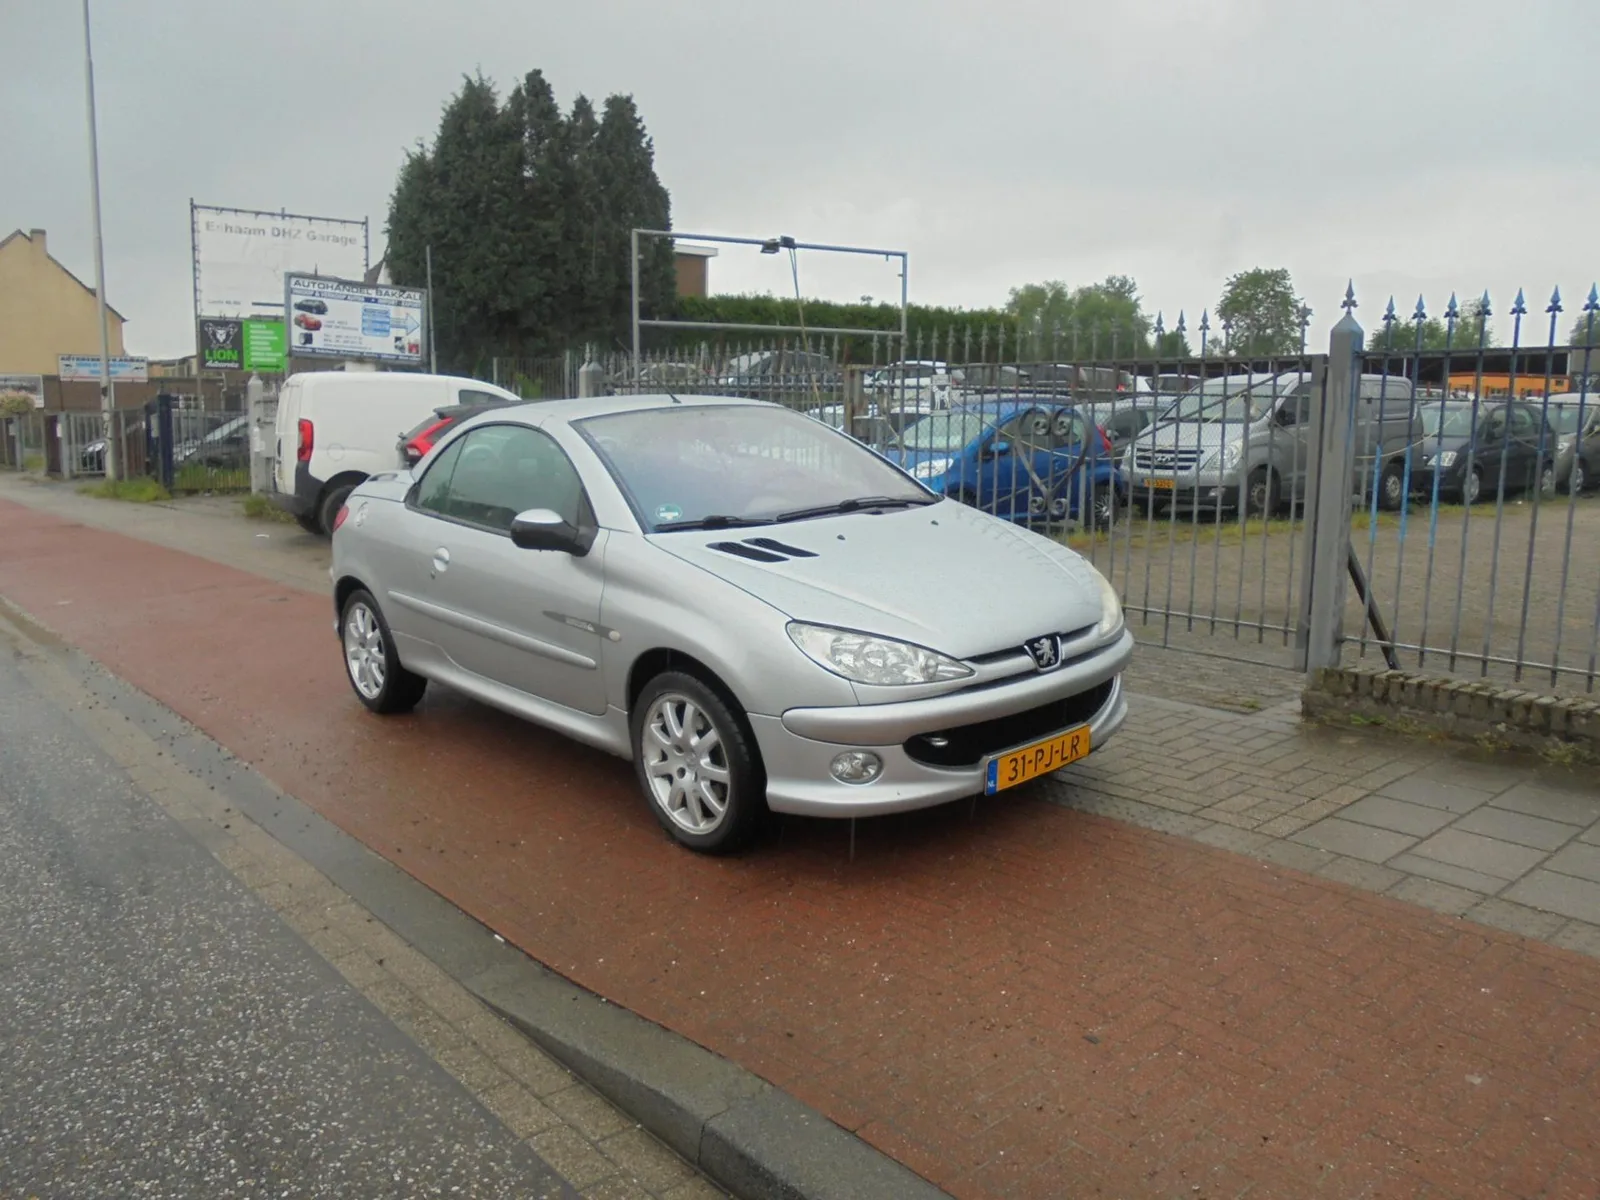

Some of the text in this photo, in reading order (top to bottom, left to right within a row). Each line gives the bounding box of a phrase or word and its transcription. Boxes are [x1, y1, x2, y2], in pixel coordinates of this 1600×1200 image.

[271, 226, 302, 240] DHZ
[306, 230, 358, 247] Garage
[293, 279, 373, 295] AUTOHANDEL
[375, 287, 421, 300] BAKKALI
[205, 349, 239, 361] LION
[1008, 734, 1080, 782] 31-PJ-LR
[987, 780, 996, 788] NL
